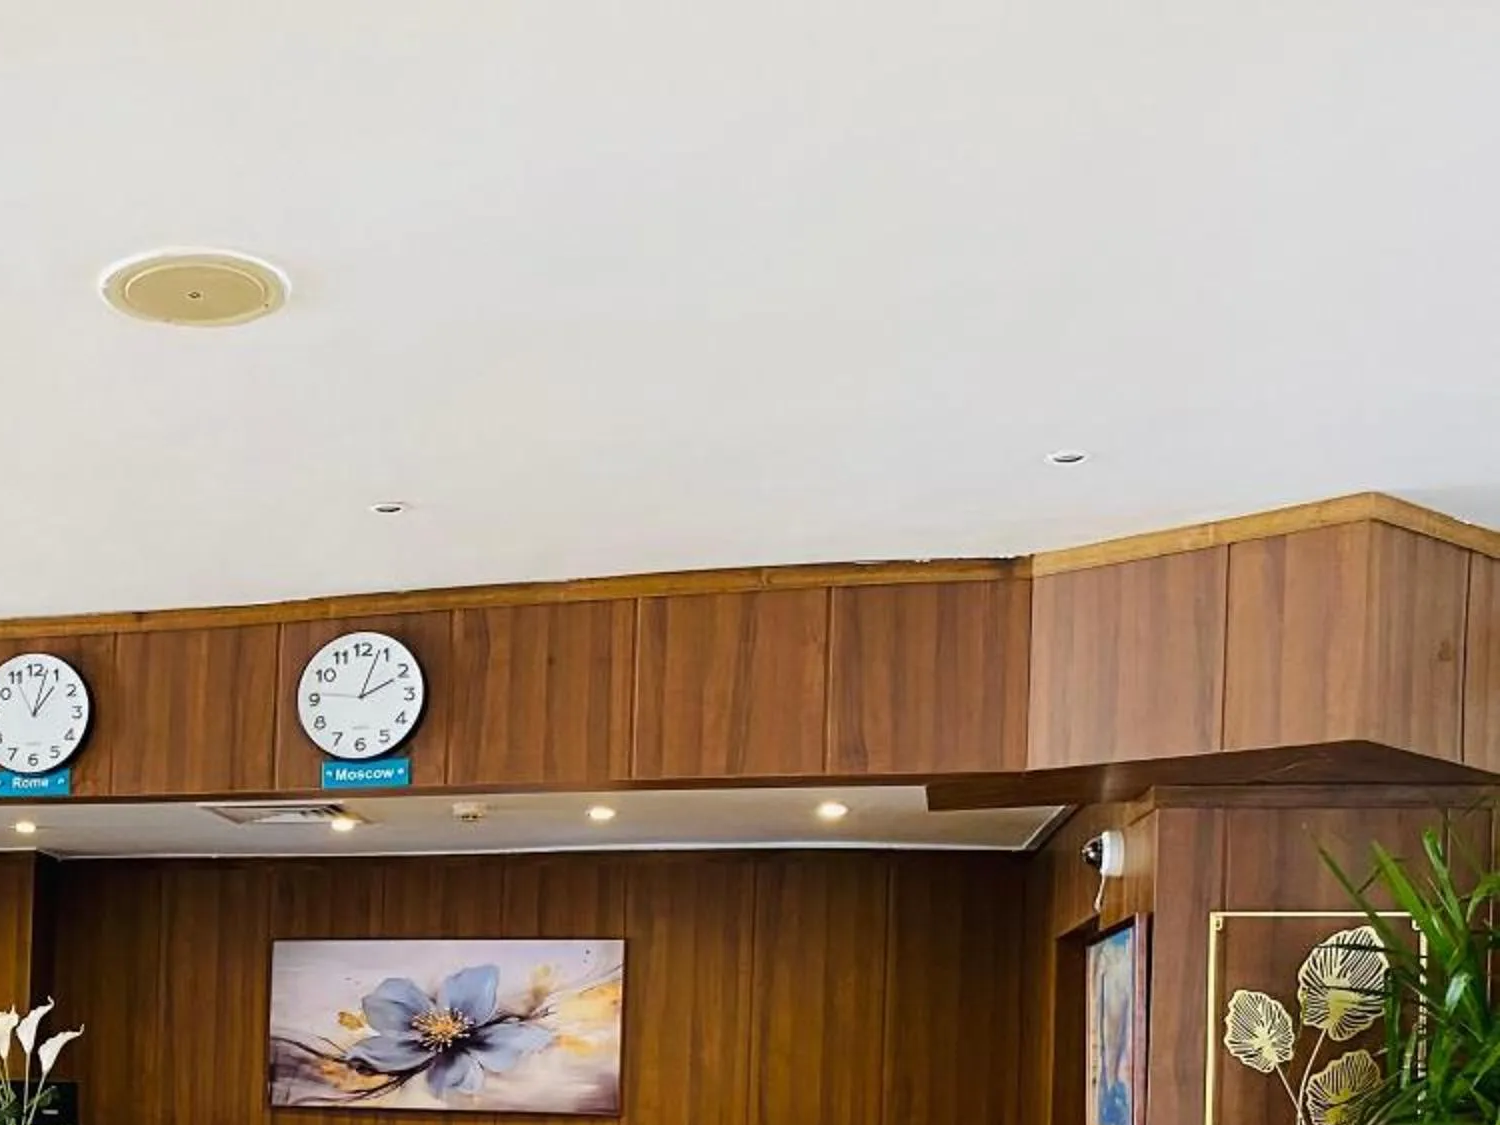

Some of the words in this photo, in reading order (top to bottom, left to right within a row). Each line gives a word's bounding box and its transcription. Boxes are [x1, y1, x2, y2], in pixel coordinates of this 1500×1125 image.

[353, 642, 373, 657] 12
[383, 647, 389, 662] 1
[333, 651, 348, 665] 11
[8, 670, 23, 684] 11
[27, 664, 44, 677] 12
[53, 668, 59, 682] 1
[316, 668, 337, 683] 10
[397, 663, 409, 678] 2
[66, 684, 77, 697] 2
[403, 687, 415, 701] 3
[309, 693, 320, 707] 9
[71, 706, 83, 719] 3
[395, 711, 407, 725] 4
[314, 715, 327, 730] 8
[64, 728, 75, 741] 4
[332, 732, 343, 746] 7
[379, 729, 391, 743] 5
[354, 738, 366, 751] 6
[7, 747, 18, 760] 7
[27, 753, 38, 766] 6
[50, 746, 60, 759] 5
[335, 768, 395, 781] Moscow
[11, 778, 49, 789] Rome
